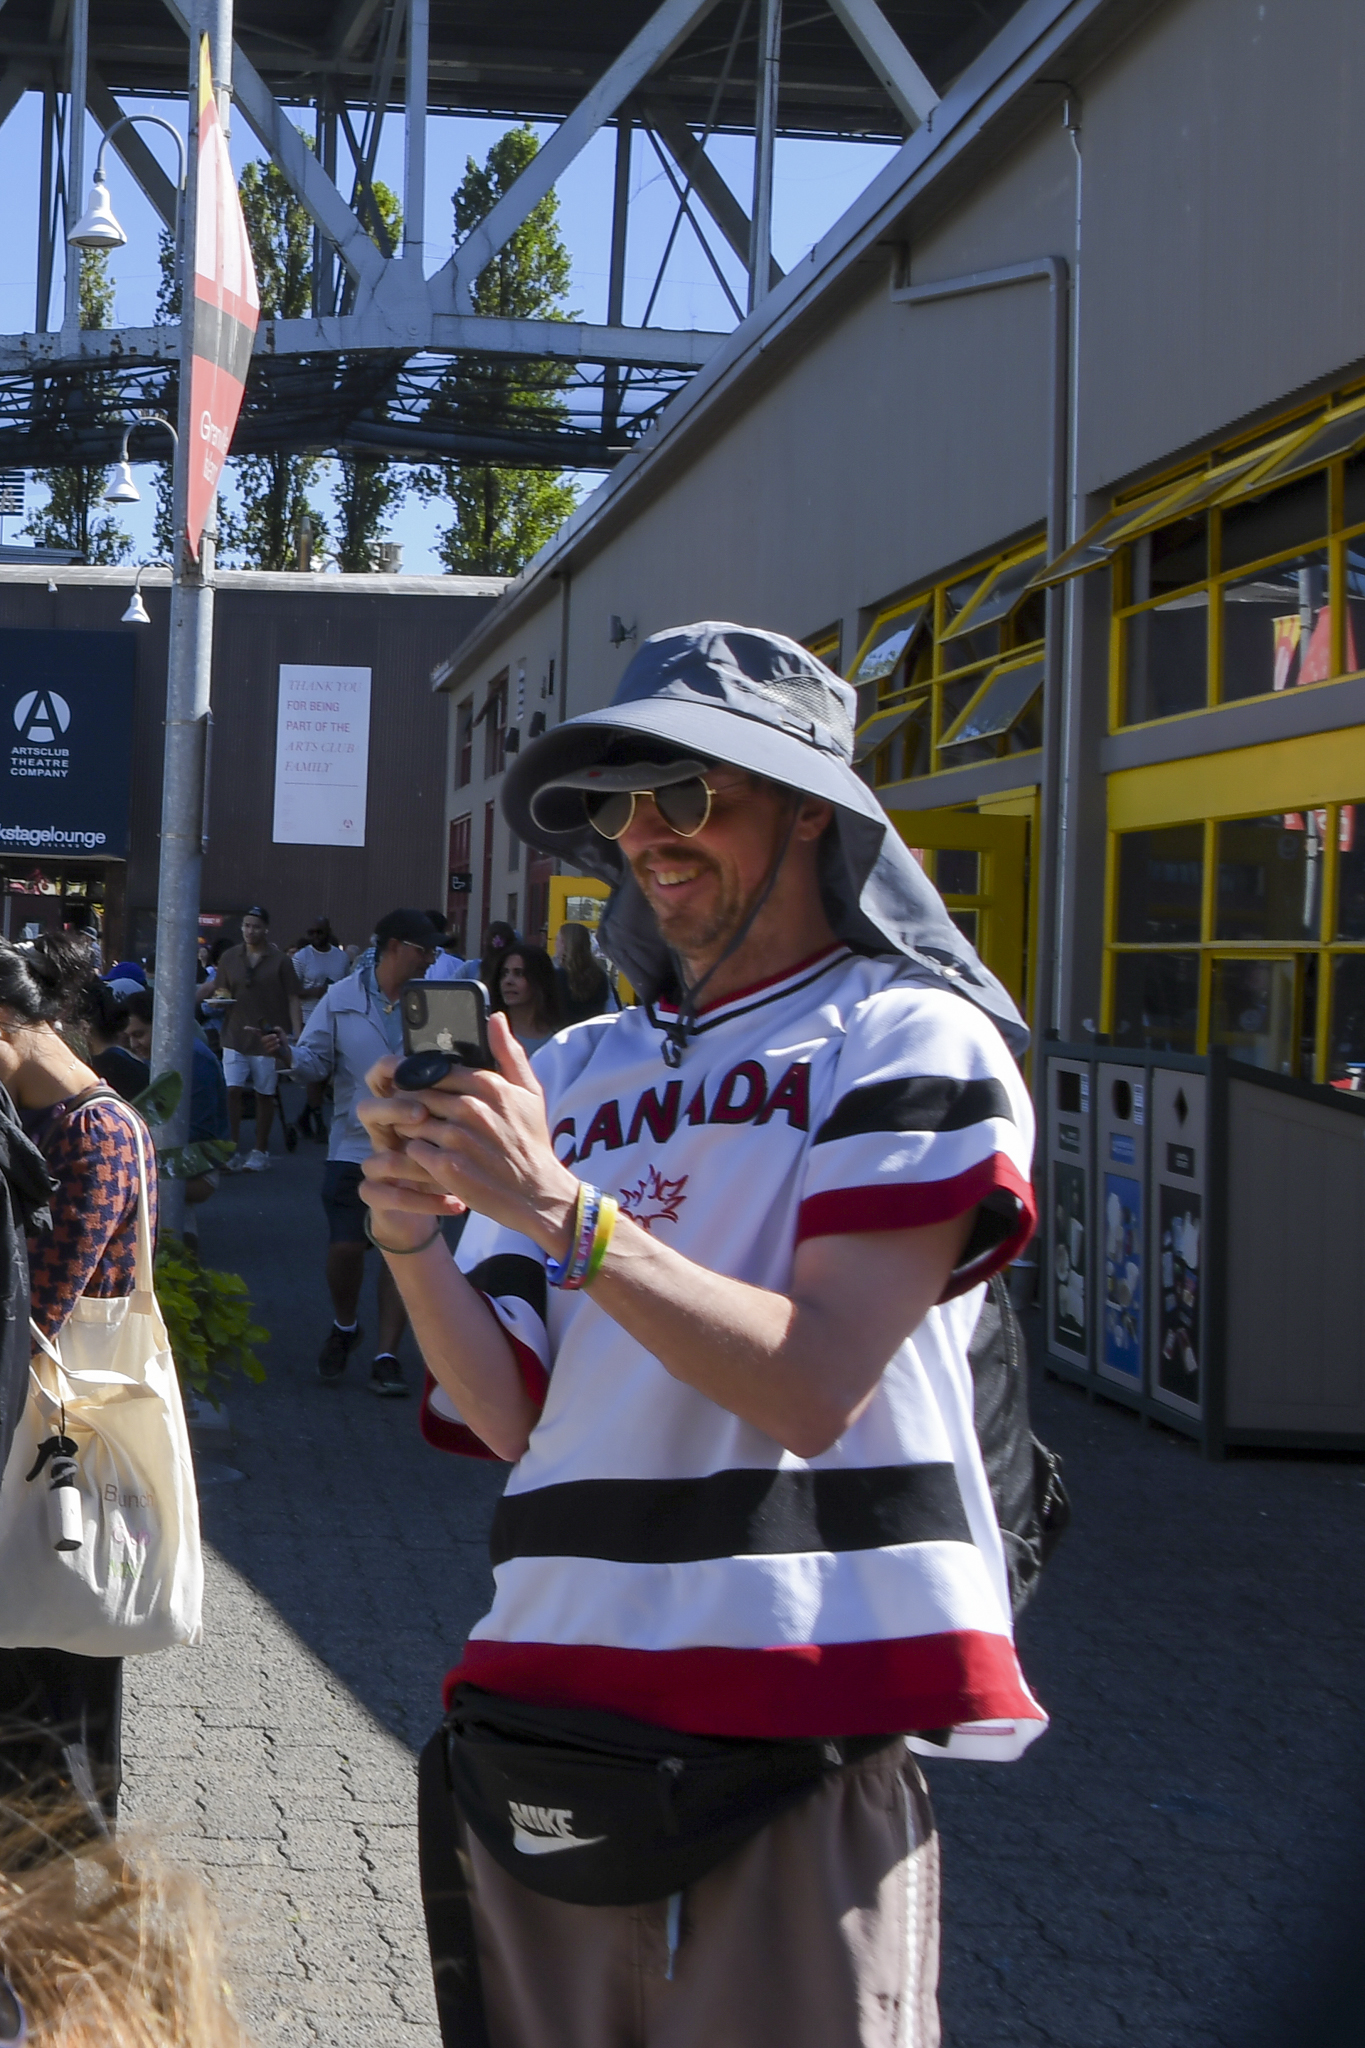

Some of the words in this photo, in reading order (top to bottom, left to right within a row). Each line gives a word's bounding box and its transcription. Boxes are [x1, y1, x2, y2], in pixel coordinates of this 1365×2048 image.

[289, 680, 334, 692] THANK
[337, 681, 362, 693] YOU
[287, 700, 307, 711] FOR
[309, 701, 340, 712] BEING
[286, 720, 312, 731] PART
[315, 721, 328, 732] OF
[331, 722, 351, 733] THE
[11, 746, 70, 757] ARTSCLUB
[285, 741, 318, 752] ARTS
[321, 742, 355, 753] CLUB
[10, 757, 70, 768] THEATRE
[285, 761, 333, 773] FAMILY
[10, 767, 69, 778] COMPANY
[551, 1059, 811, 1168] CANADA
[104, 1483, 155, 1509] Bunch
[508, 1800, 575, 1841] NIKE
